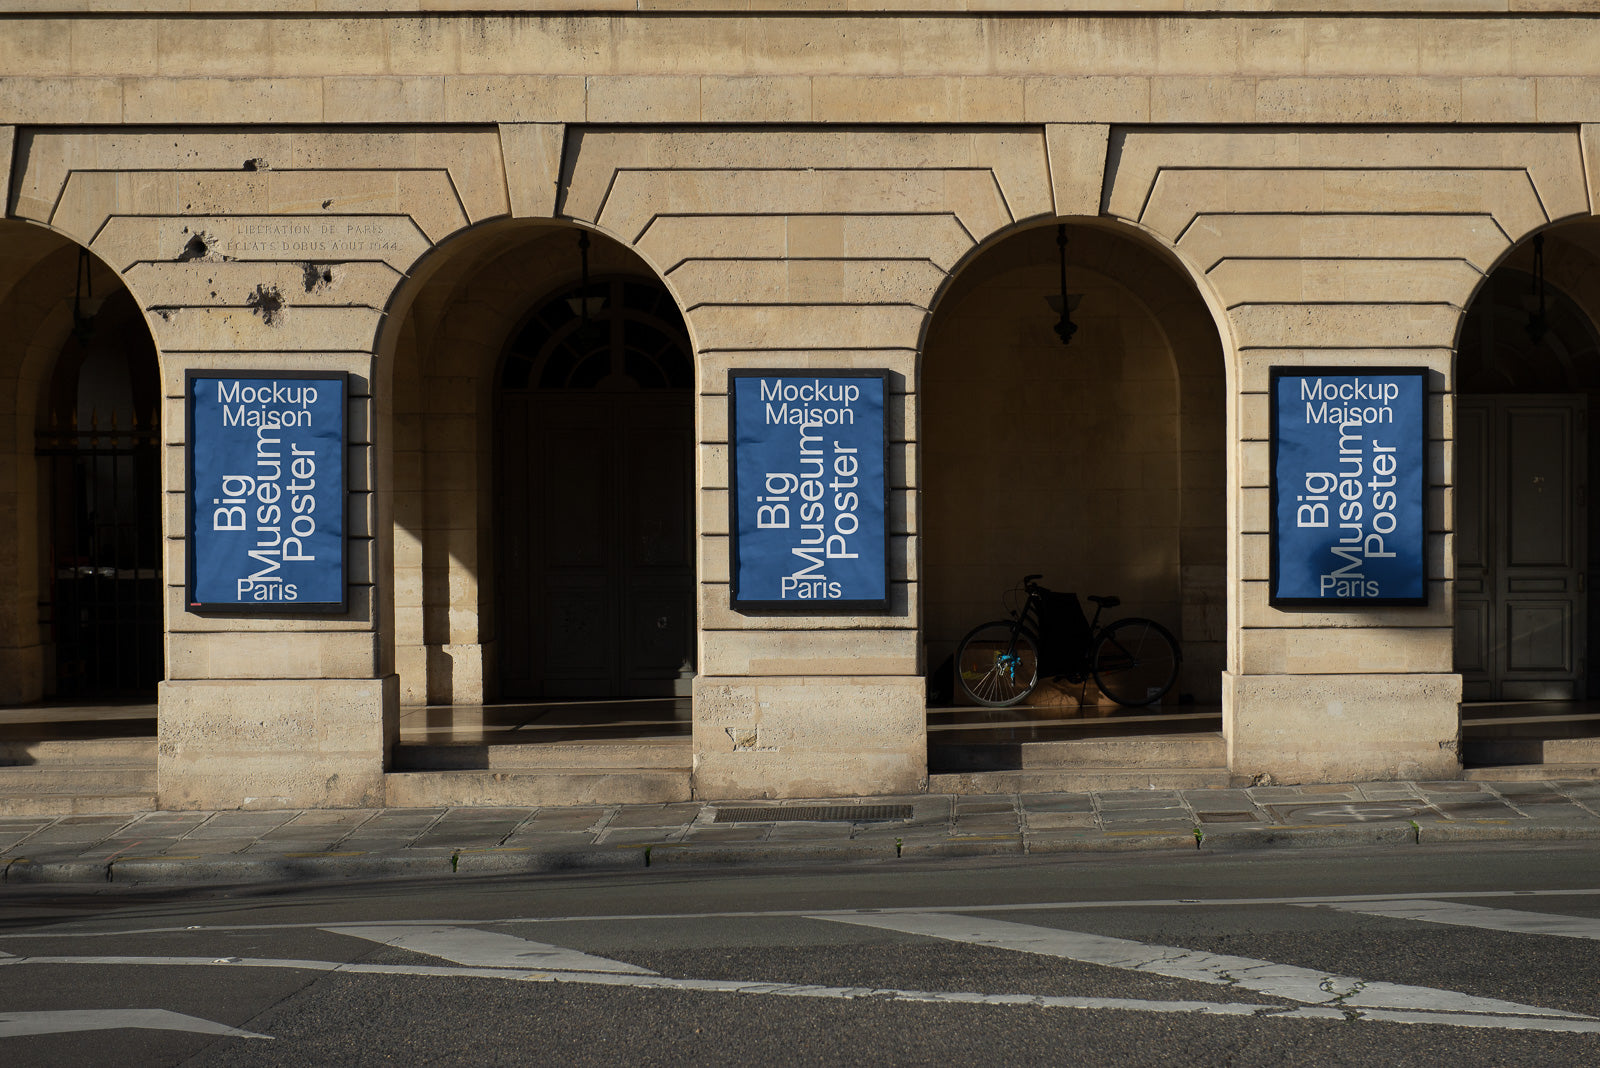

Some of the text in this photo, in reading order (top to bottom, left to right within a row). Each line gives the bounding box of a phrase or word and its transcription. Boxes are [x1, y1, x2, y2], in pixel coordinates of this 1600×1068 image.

[321, 224, 336, 234] DE
[346, 224, 384, 235] PARIS
[218, 381, 318, 409] Mockup
[760, 379, 860, 407] Mockup
[1301, 378, 1399, 405] Mockup
[223, 405, 312, 427] Maison
[766, 402, 854, 425] Maison
[1306, 401, 1393, 424] Maison
[213, 475, 256, 531] Big
[248, 421, 281, 582] Museum
[282, 443, 316, 561] Poster
[757, 473, 799, 529] Big
[792, 419, 825, 580] Museum
[826, 441, 859, 559] Poster
[1297, 472, 1338, 528] Big
[1330, 418, 1363, 579] Museum
[1364, 440, 1397, 558] Poster
[237, 578, 298, 601] Paris
[781, 576, 842, 599] Paris
[1320, 574, 1379, 597] Paris
